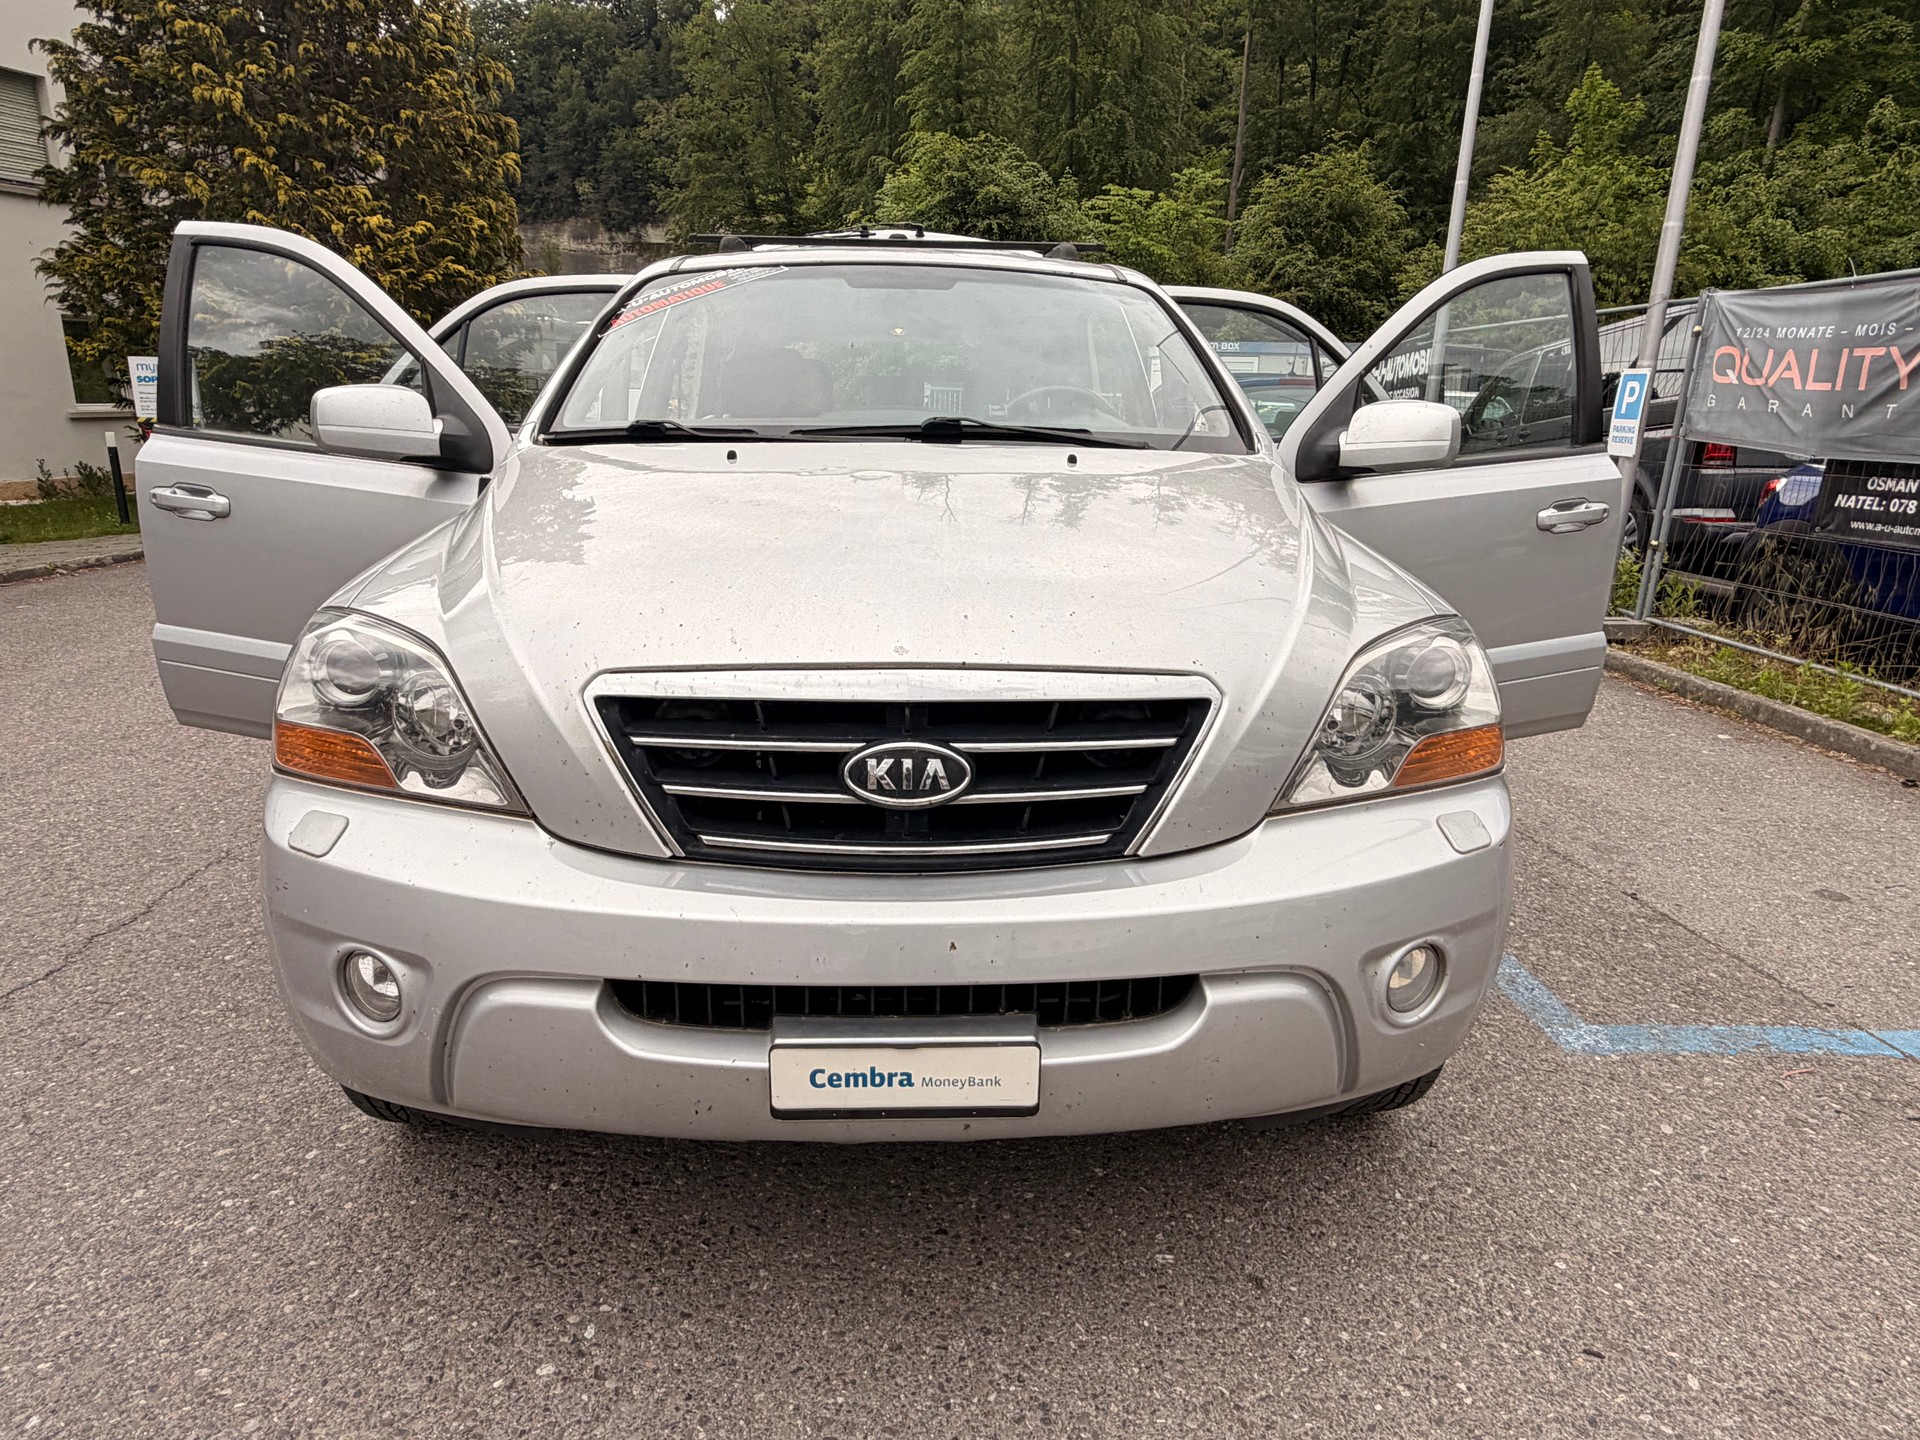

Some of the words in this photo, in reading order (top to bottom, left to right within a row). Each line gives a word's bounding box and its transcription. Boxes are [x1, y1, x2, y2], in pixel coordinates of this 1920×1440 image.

[610, 281, 727, 328] AUTOMATIQUE
[1736, 327, 1769, 338] 12/24
[1776, 326, 1835, 338] MONATE
[1855, 323, 1897, 337] MOIS
[1713, 346, 1920, 391] QUALITY
[1620, 381, 1640, 414] P
[1612, 425, 1636, 434] PARKING
[1867, 476, 1919, 493] OSMAN
[1834, 494, 1887, 511] NATEL:
[1889, 498, 1918, 514] 078
[866, 758, 950, 790] KIA
[809, 1066, 915, 1088] Cembra
[921, 1075, 1002, 1090] MoneyBank
